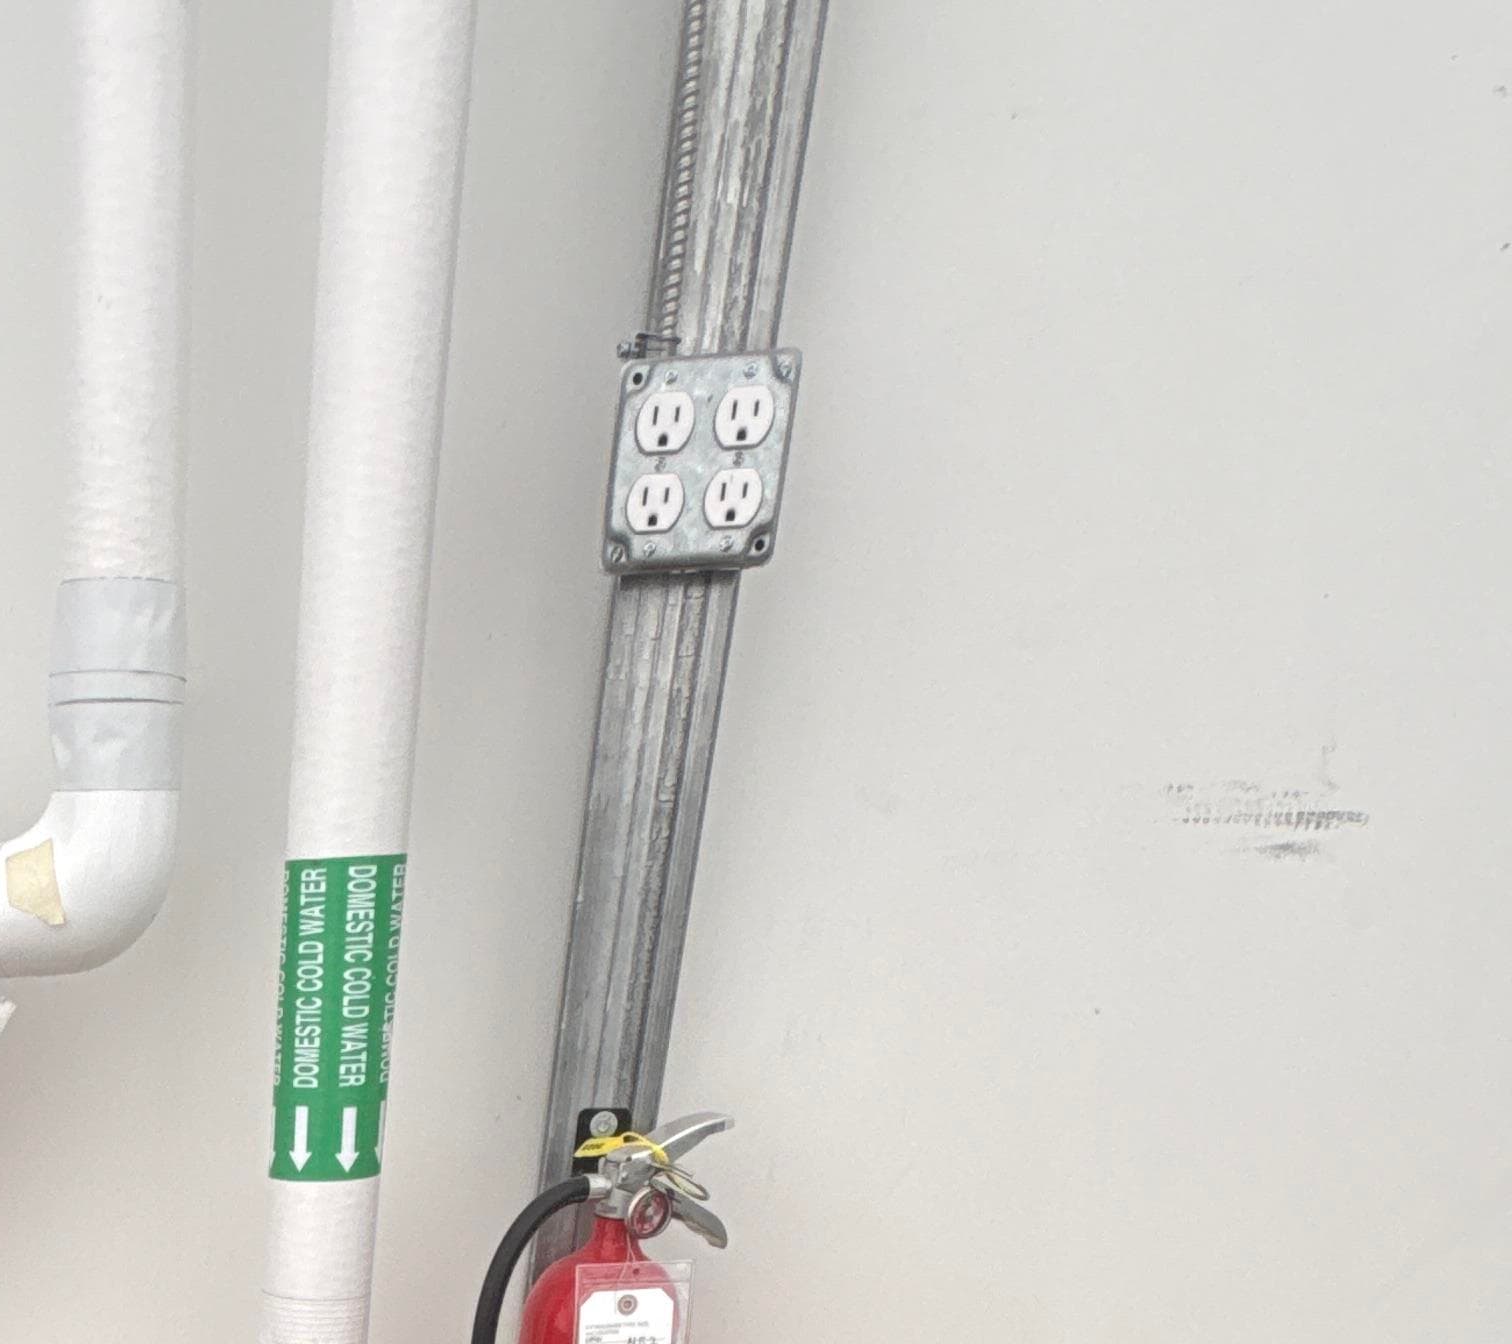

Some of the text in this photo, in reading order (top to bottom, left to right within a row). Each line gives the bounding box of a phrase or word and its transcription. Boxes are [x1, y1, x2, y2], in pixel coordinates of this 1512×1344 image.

[292, 867, 327, 1088] DOMESTIC COLD WATER
[338, 864, 377, 1088] DOMESTIC COLD WATER
[390, 863, 406, 931] WATER
